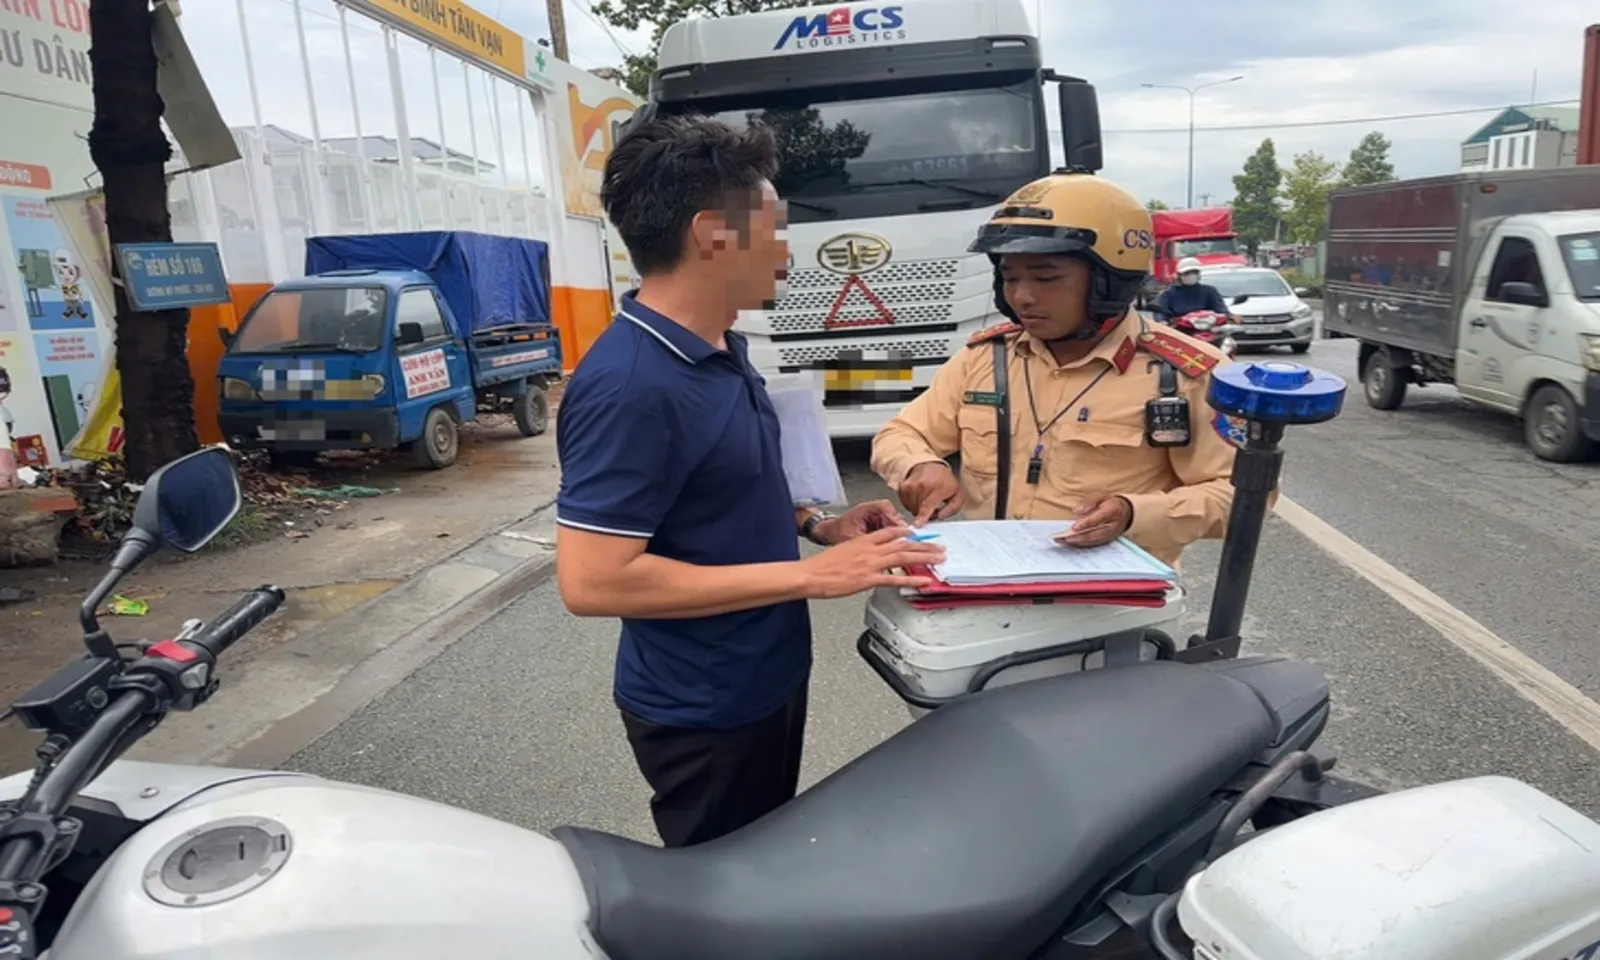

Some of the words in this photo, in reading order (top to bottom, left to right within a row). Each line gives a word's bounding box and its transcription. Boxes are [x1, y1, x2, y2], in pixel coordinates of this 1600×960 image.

[796, 30, 907, 49] LOGISTICS
[0, 28, 24, 67] Ư
[32, 34, 91, 85] DÂN
[1123, 229, 1155, 250] CS
